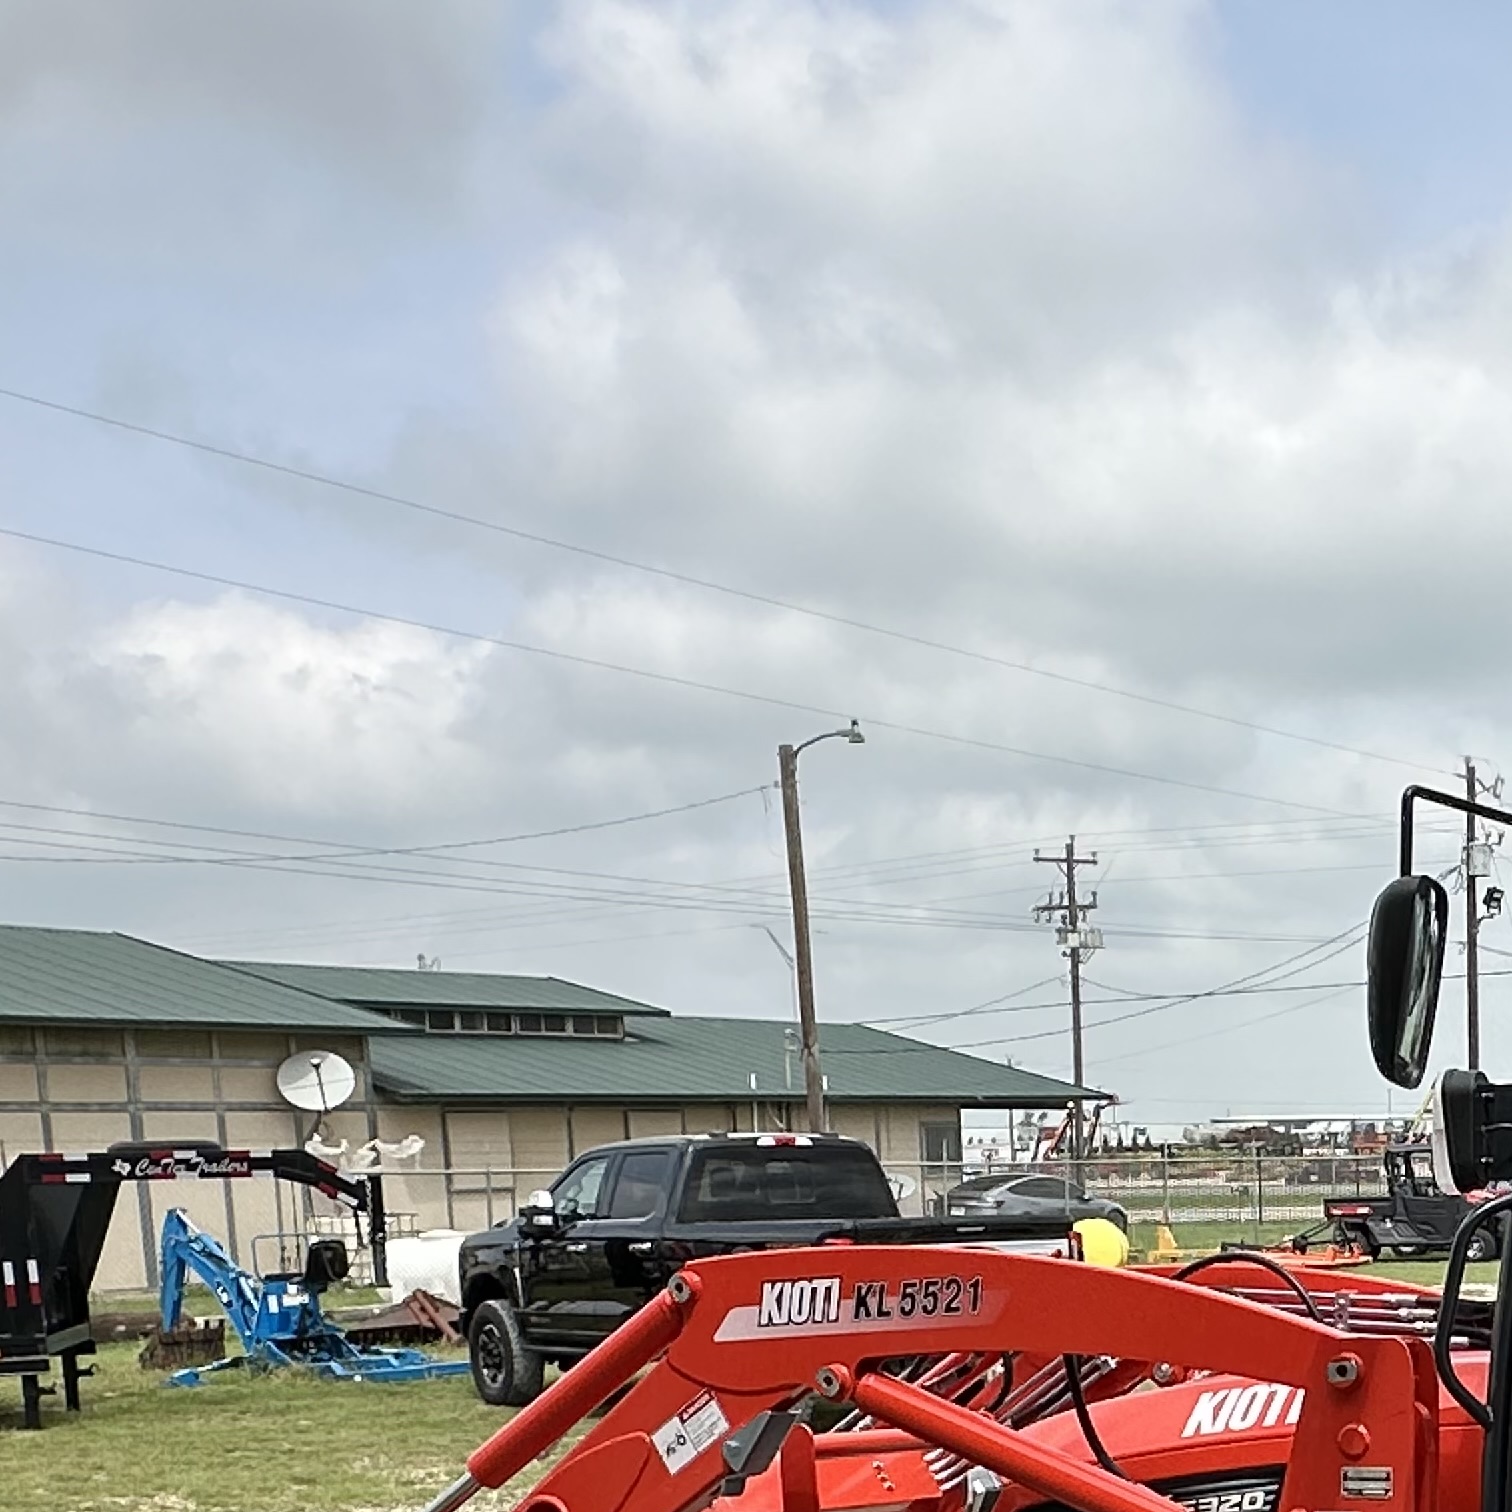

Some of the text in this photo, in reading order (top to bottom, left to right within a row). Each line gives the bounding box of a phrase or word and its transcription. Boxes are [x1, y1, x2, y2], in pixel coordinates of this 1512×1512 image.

[759, 1275, 984, 1327] KIOTI KL 5521
[1180, 1383, 1306, 1438] KIOTI
